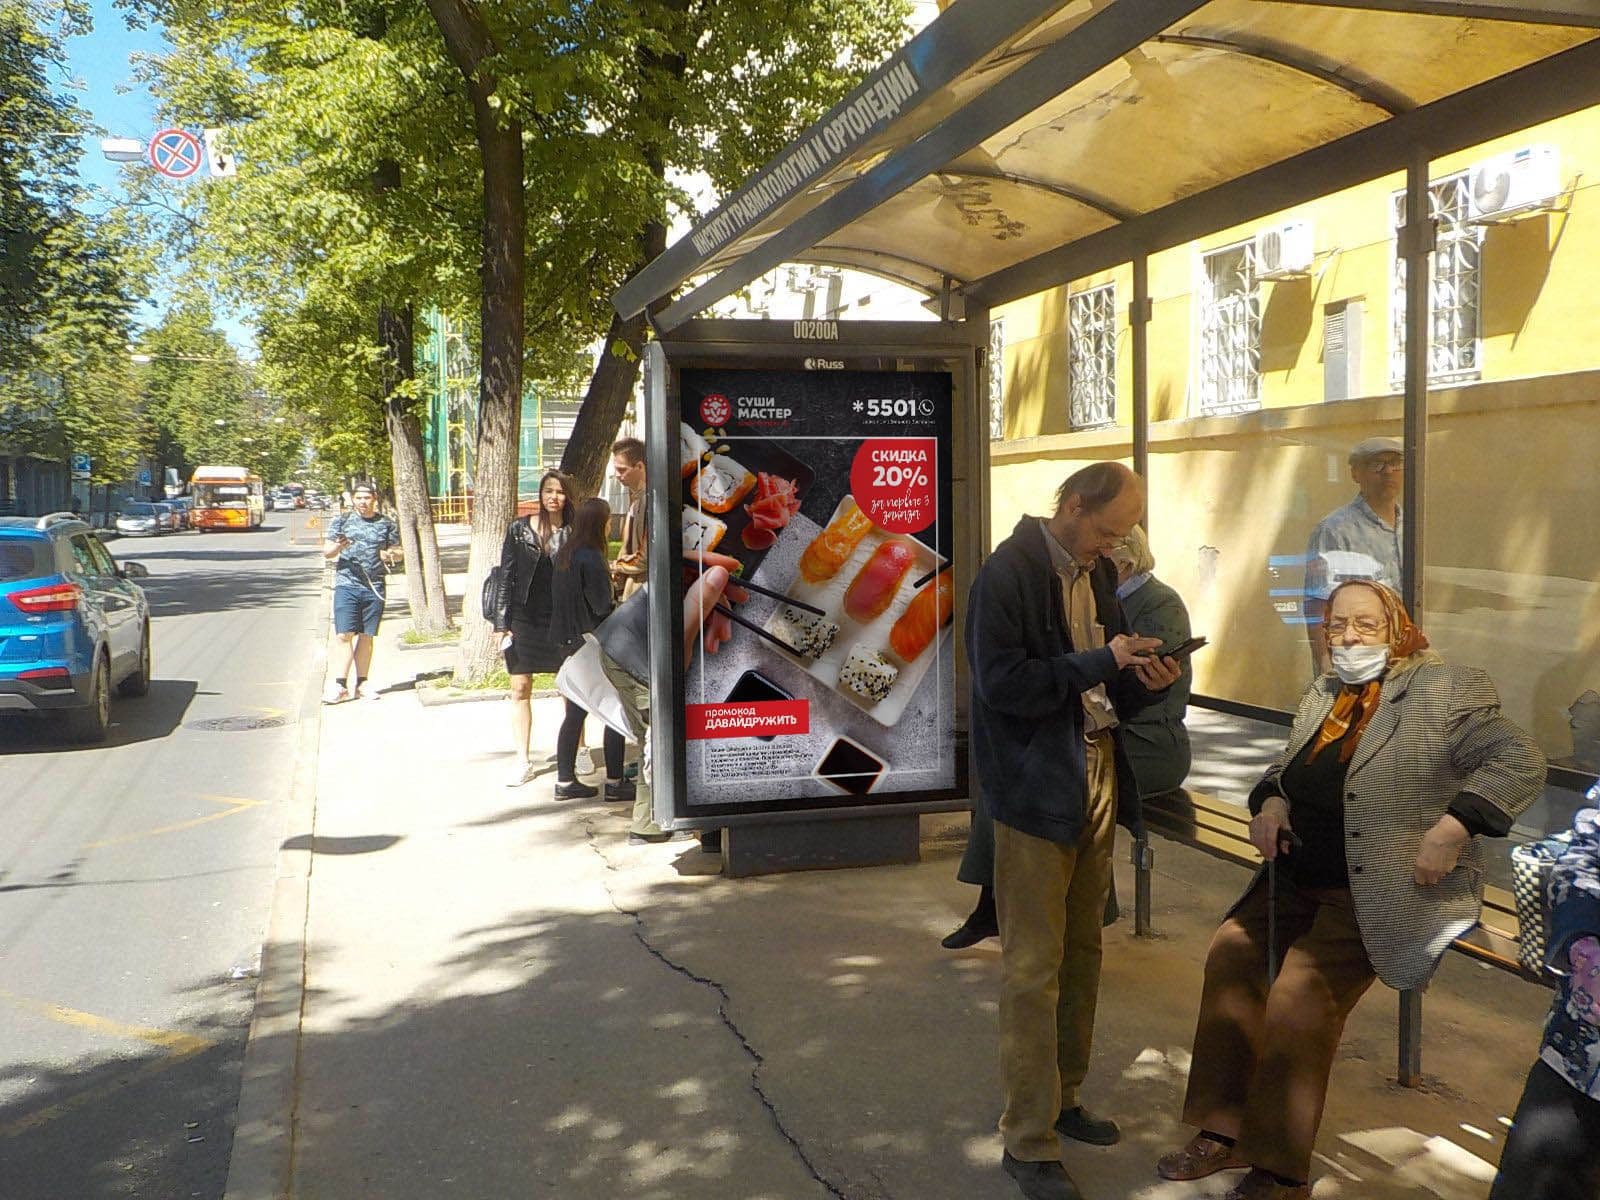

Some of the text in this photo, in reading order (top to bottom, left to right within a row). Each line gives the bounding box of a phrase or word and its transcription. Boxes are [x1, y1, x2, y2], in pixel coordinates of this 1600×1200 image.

[691, 60, 919, 256] ИНСТИТУТ ТРАВМАТОЛОГИИ И ОРТОПЕДИИ
[817, 358, 845, 369] Russ
[737, 397, 775, 407] СУШИ
[737, 408, 792, 419] МАСТЕР
[871, 450, 927, 463] СКИДКА
[872, 466, 928, 488] 20%
[705, 707, 756, 718] промокод
[705, 715, 797, 730] ДАВАЙДРУЖИТЬ
